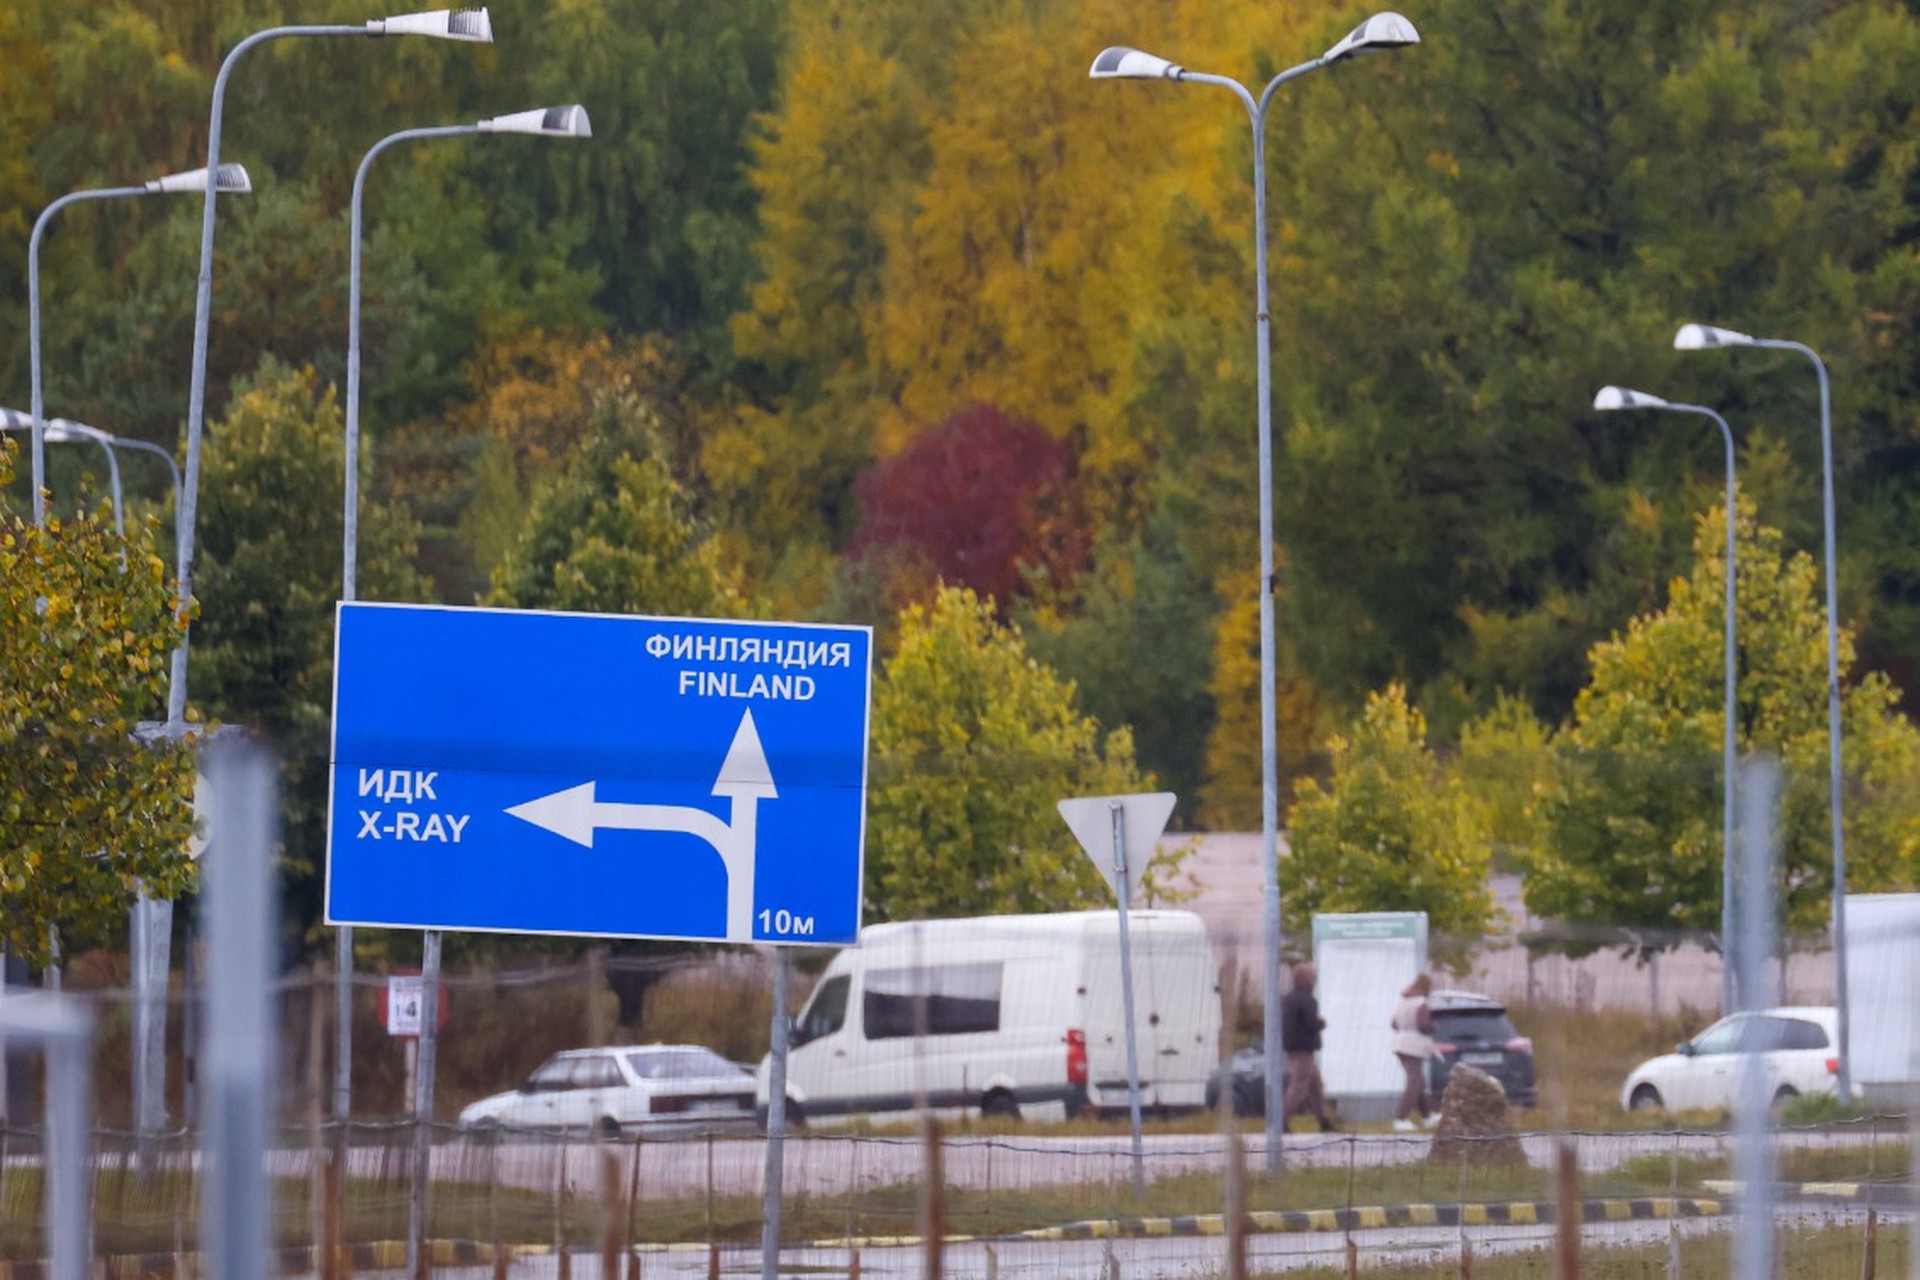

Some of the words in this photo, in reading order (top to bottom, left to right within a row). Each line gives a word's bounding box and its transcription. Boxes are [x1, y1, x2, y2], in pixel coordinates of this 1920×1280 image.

[645, 633, 851, 669] ФИНЛЯНДИЯ
[678, 671, 816, 701] FINLAND
[358, 768, 438, 804] ИДК
[357, 810, 471, 843] X-RAY
